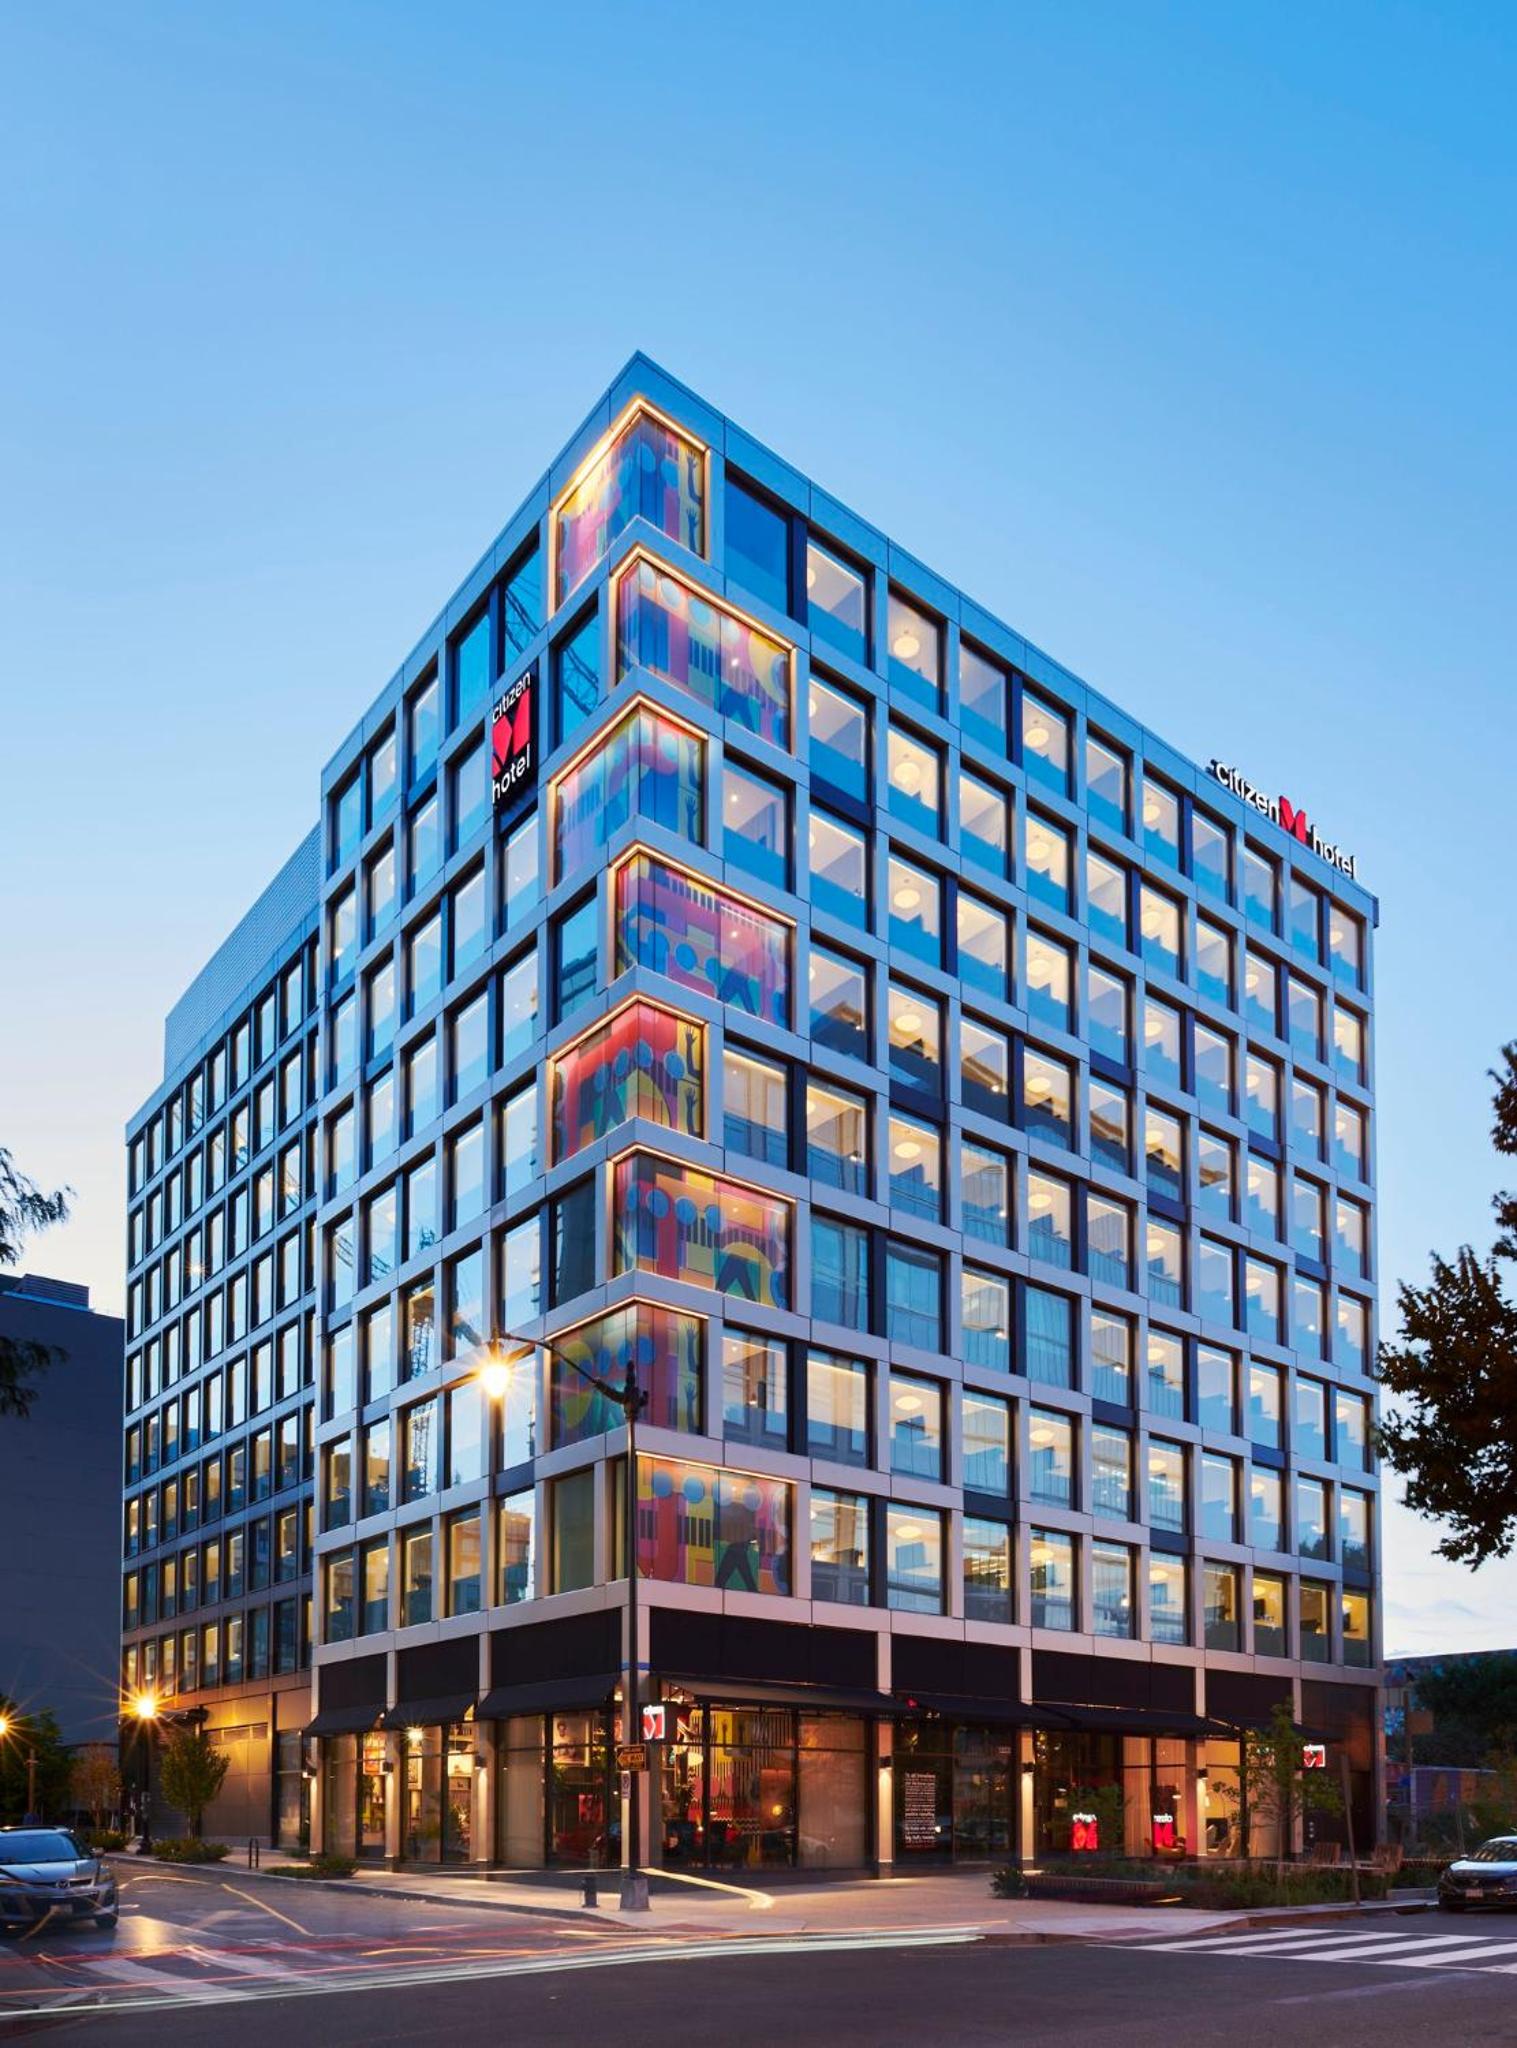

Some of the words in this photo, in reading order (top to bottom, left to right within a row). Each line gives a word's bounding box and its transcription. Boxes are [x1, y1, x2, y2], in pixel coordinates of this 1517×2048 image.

[492, 671, 531, 723] citizen
[492, 743, 530, 804] hotel
[1311, 824, 1357, 880] hotel
